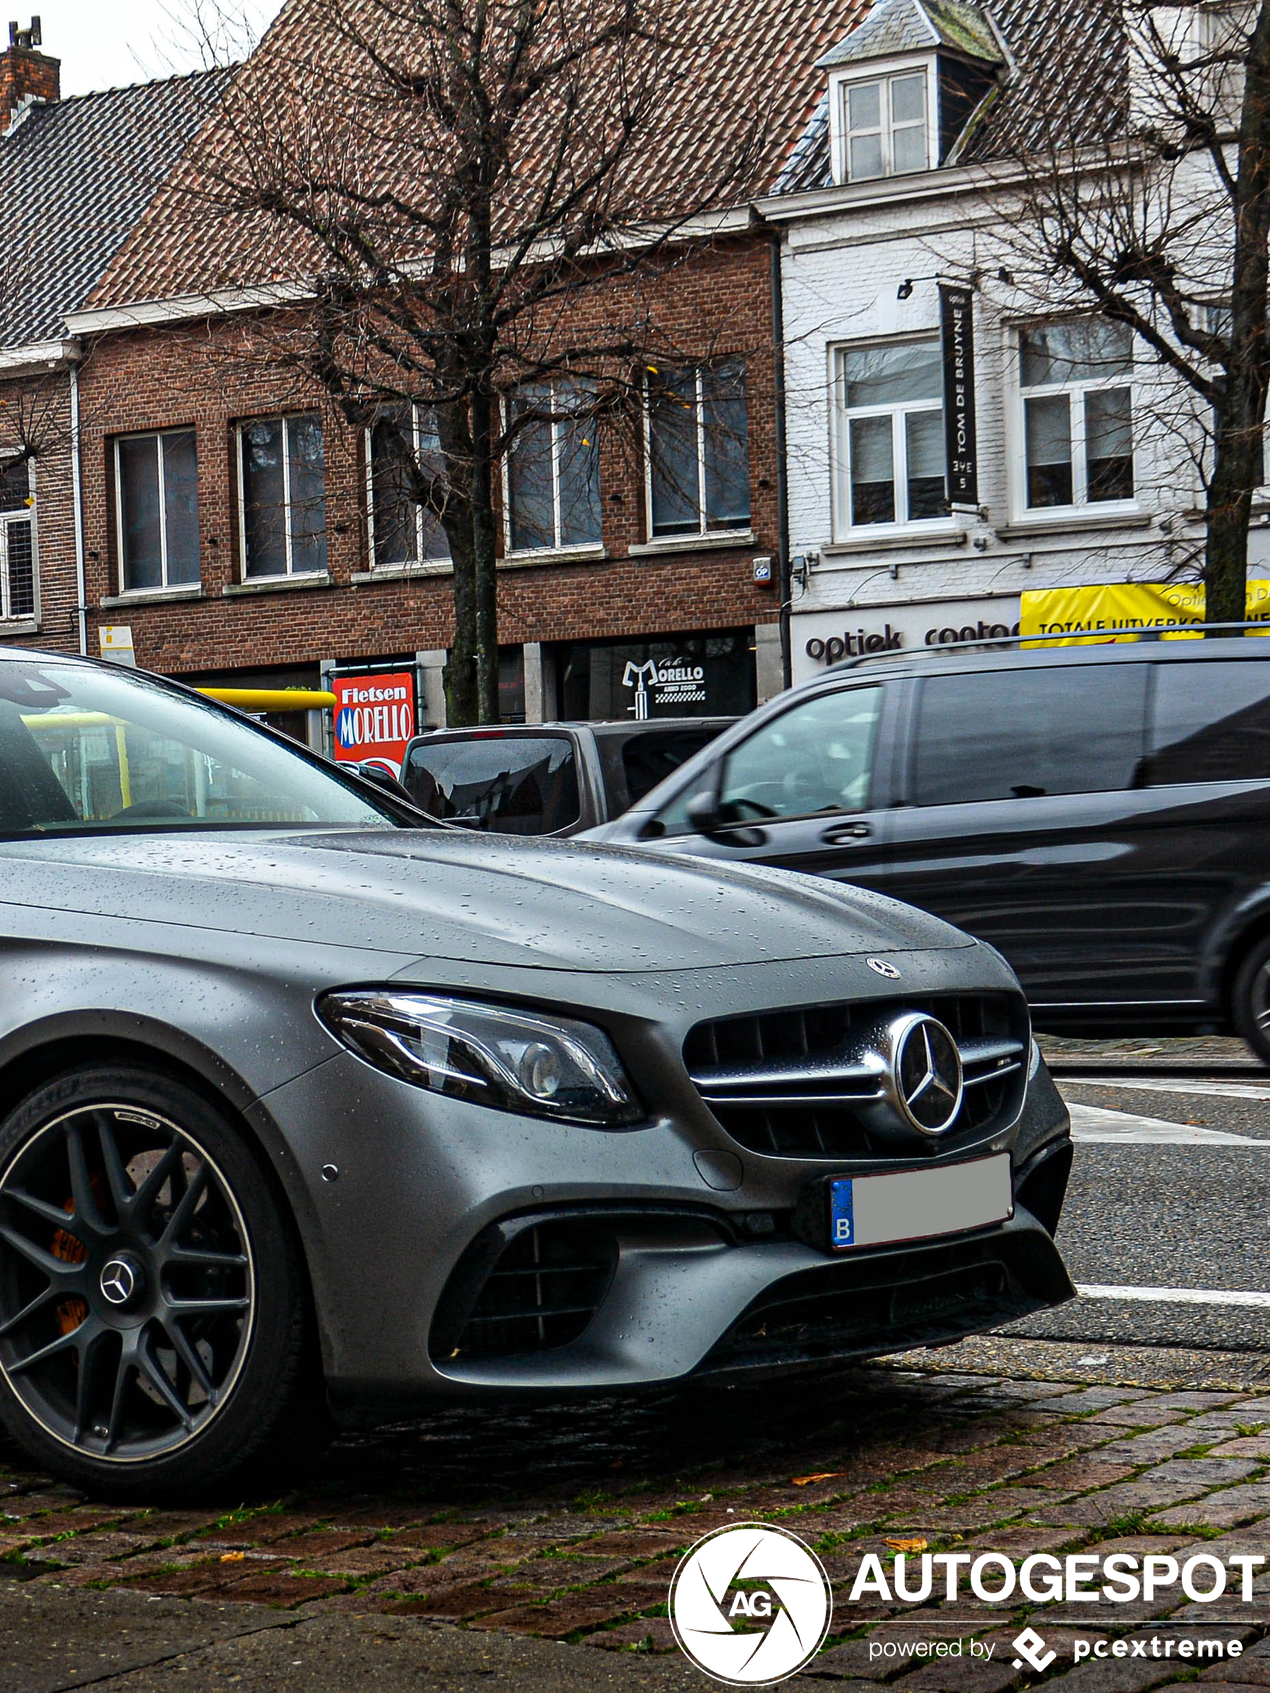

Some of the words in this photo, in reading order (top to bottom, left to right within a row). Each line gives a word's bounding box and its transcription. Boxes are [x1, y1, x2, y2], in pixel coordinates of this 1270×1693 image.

[953, 308, 964, 378] BRUYNE
[956, 384, 965, 407] DE
[957, 413, 966, 453] TOM
[805, 624, 903, 666] optiek
[341, 686, 407, 704] Fietsen
[340, 703, 412, 746] MORELLO
[836, 1218, 851, 1240] B
